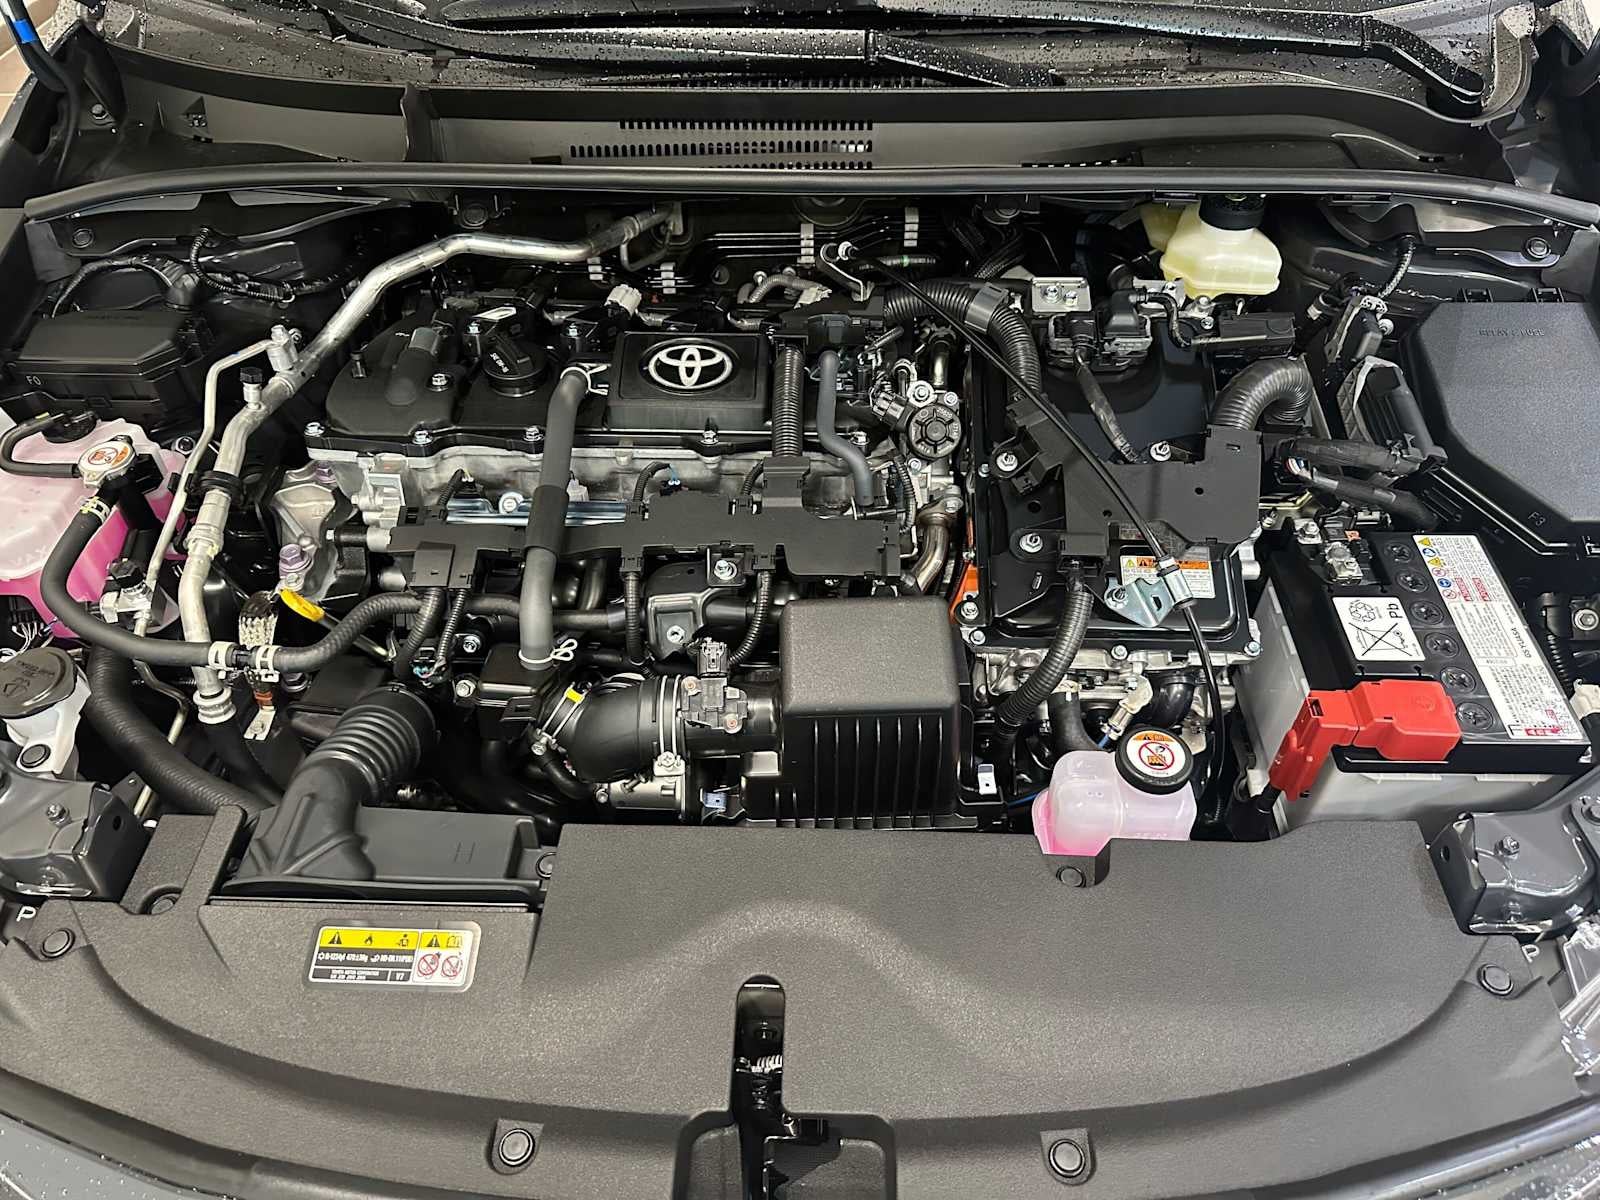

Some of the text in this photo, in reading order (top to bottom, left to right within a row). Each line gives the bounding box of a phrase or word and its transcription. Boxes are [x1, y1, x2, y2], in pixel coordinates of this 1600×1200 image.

[1387, 603, 1403, 619] Pb
[1511, 627, 1532, 658] GS YUASA
[16, 905, 37, 922] P
[1521, 944, 1540, 963] P
